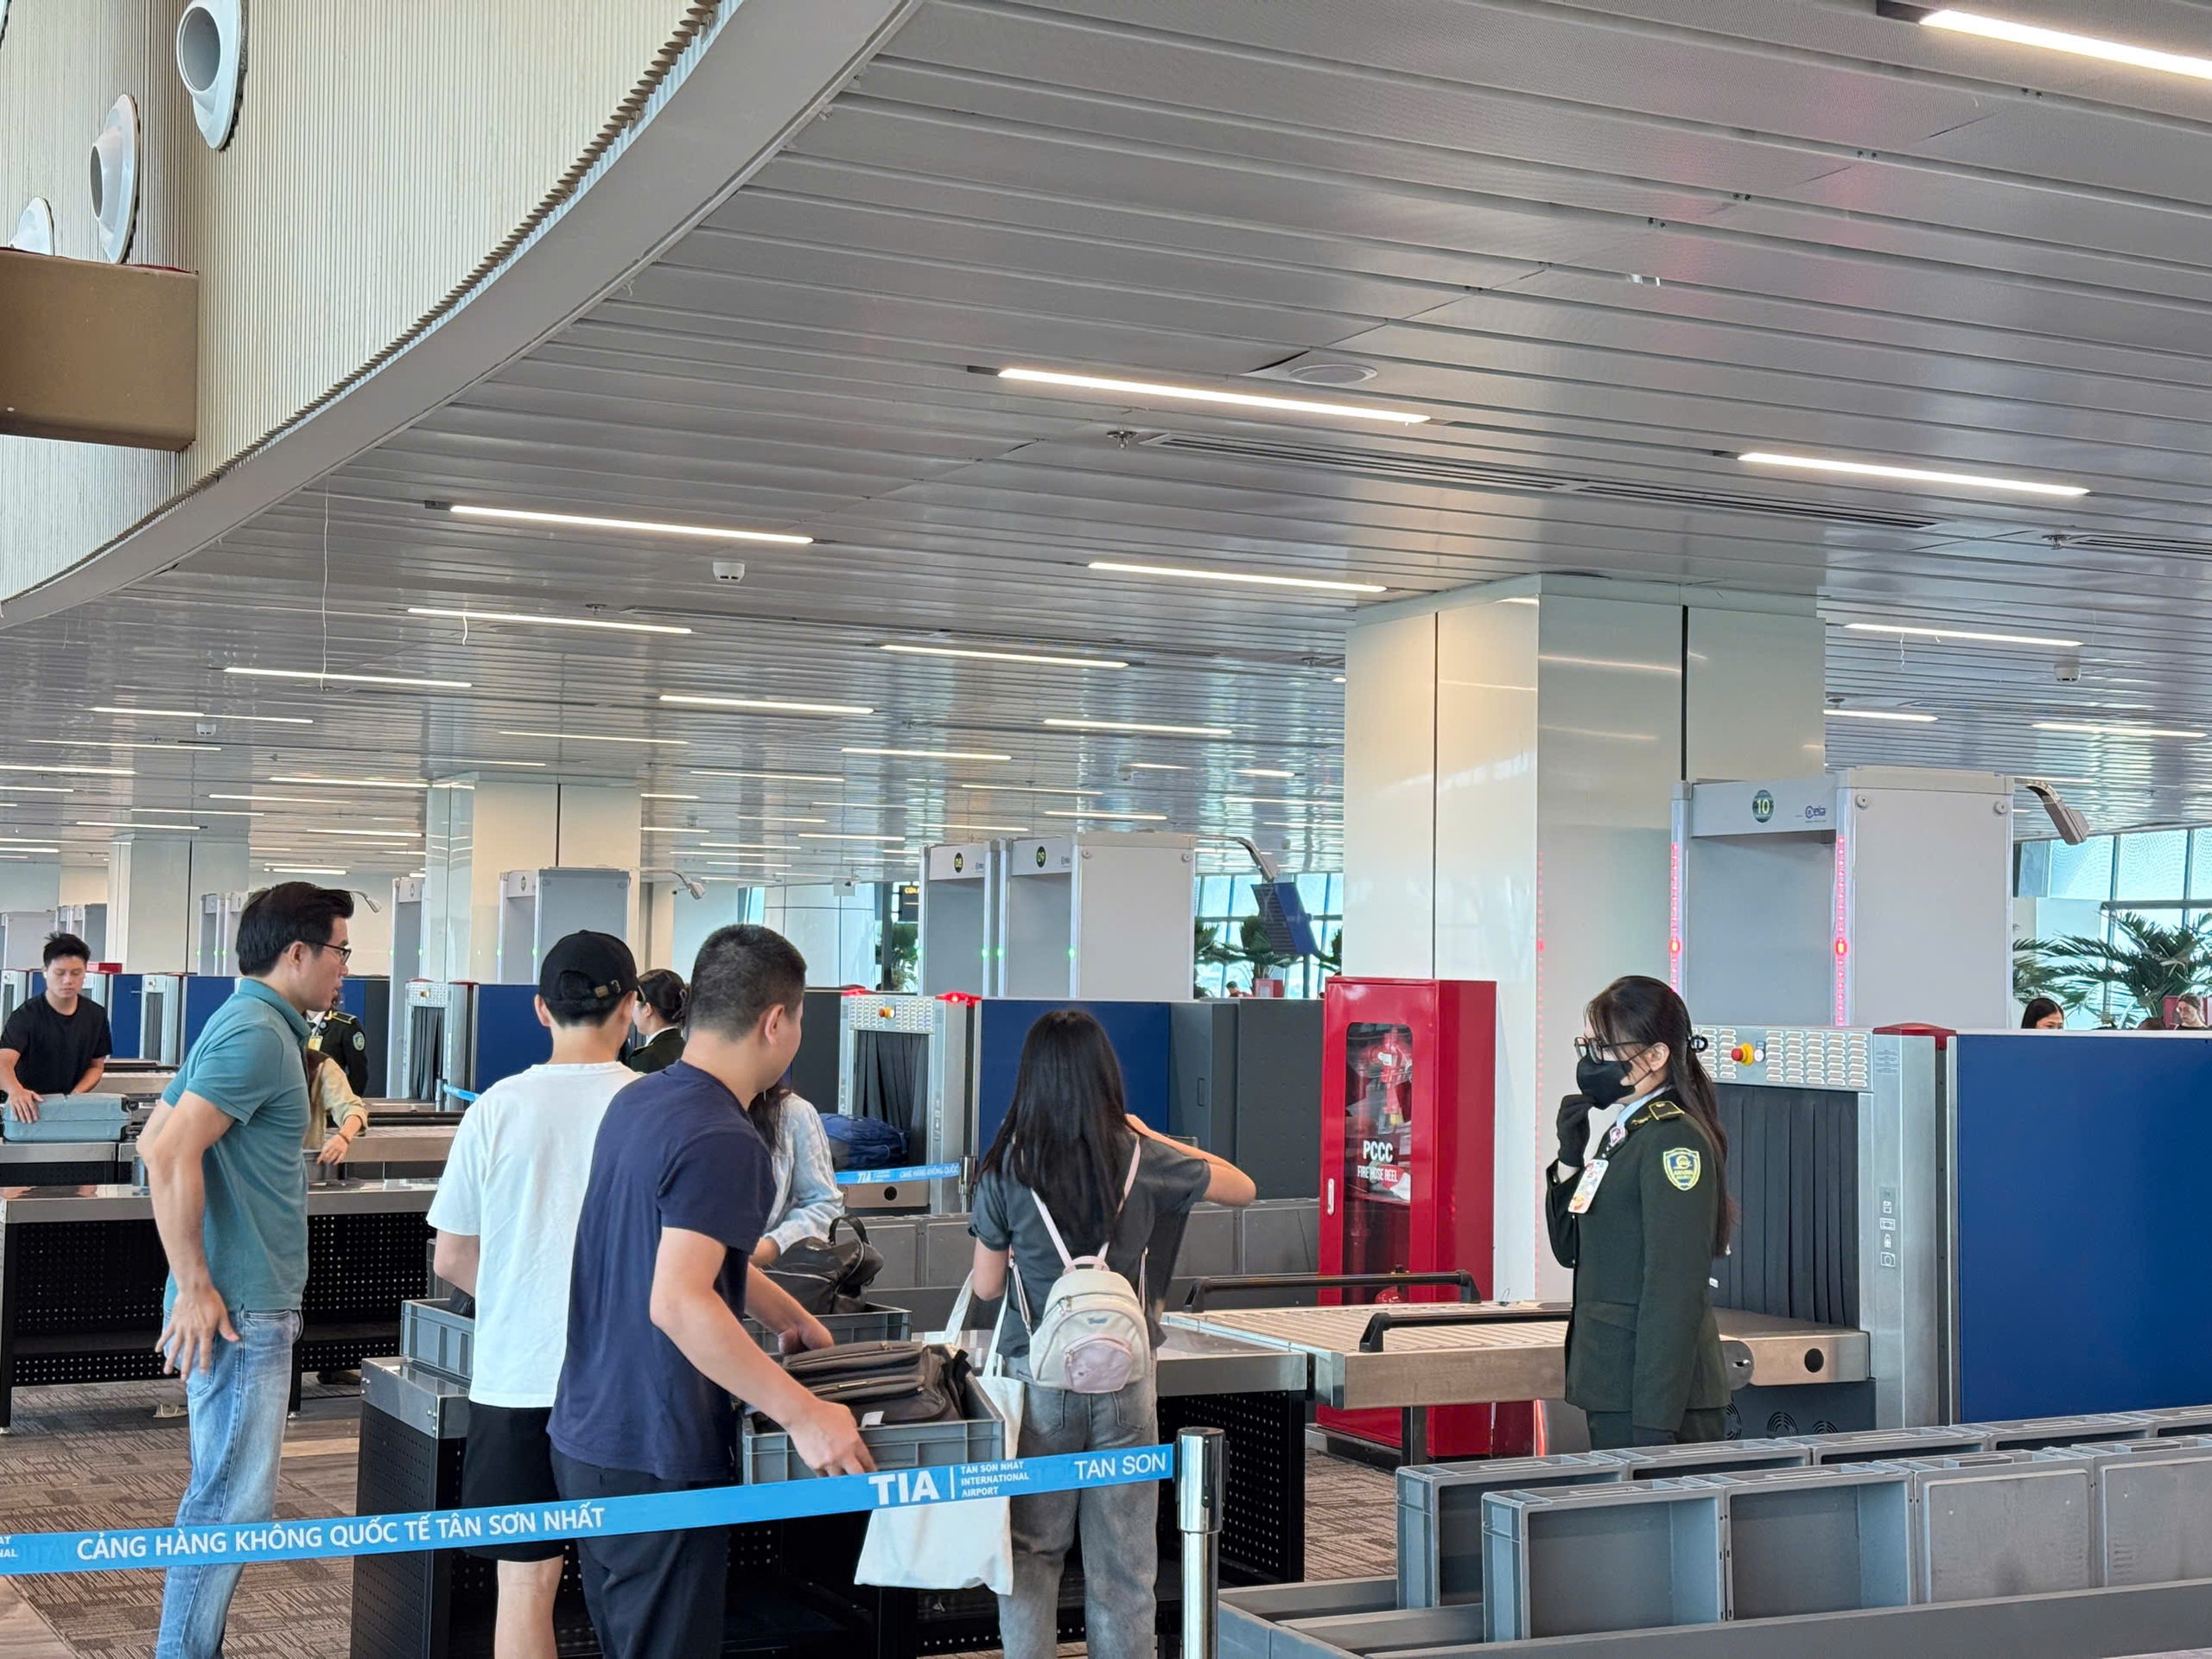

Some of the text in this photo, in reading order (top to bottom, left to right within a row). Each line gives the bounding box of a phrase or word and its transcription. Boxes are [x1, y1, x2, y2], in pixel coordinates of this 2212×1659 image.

[1757, 798, 1770, 814] 10
[1363, 1140, 1393, 1162] PCCC
[1357, 1165, 1399, 1183] FIRE HOSE REEL
[961, 1460, 1025, 1476] TAN SON NHAT
[1074, 1452, 1166, 1480] TAN SON
[868, 1471, 940, 1505] TIA
[961, 1471, 1030, 1487] INTERNATIONAL
[961, 1486, 999, 1498] AIRPORT
[77, 1502, 606, 1561] CẢNG HÀNG KHÔNG QUỐC TẾ TÂN SƠN NHẤT
